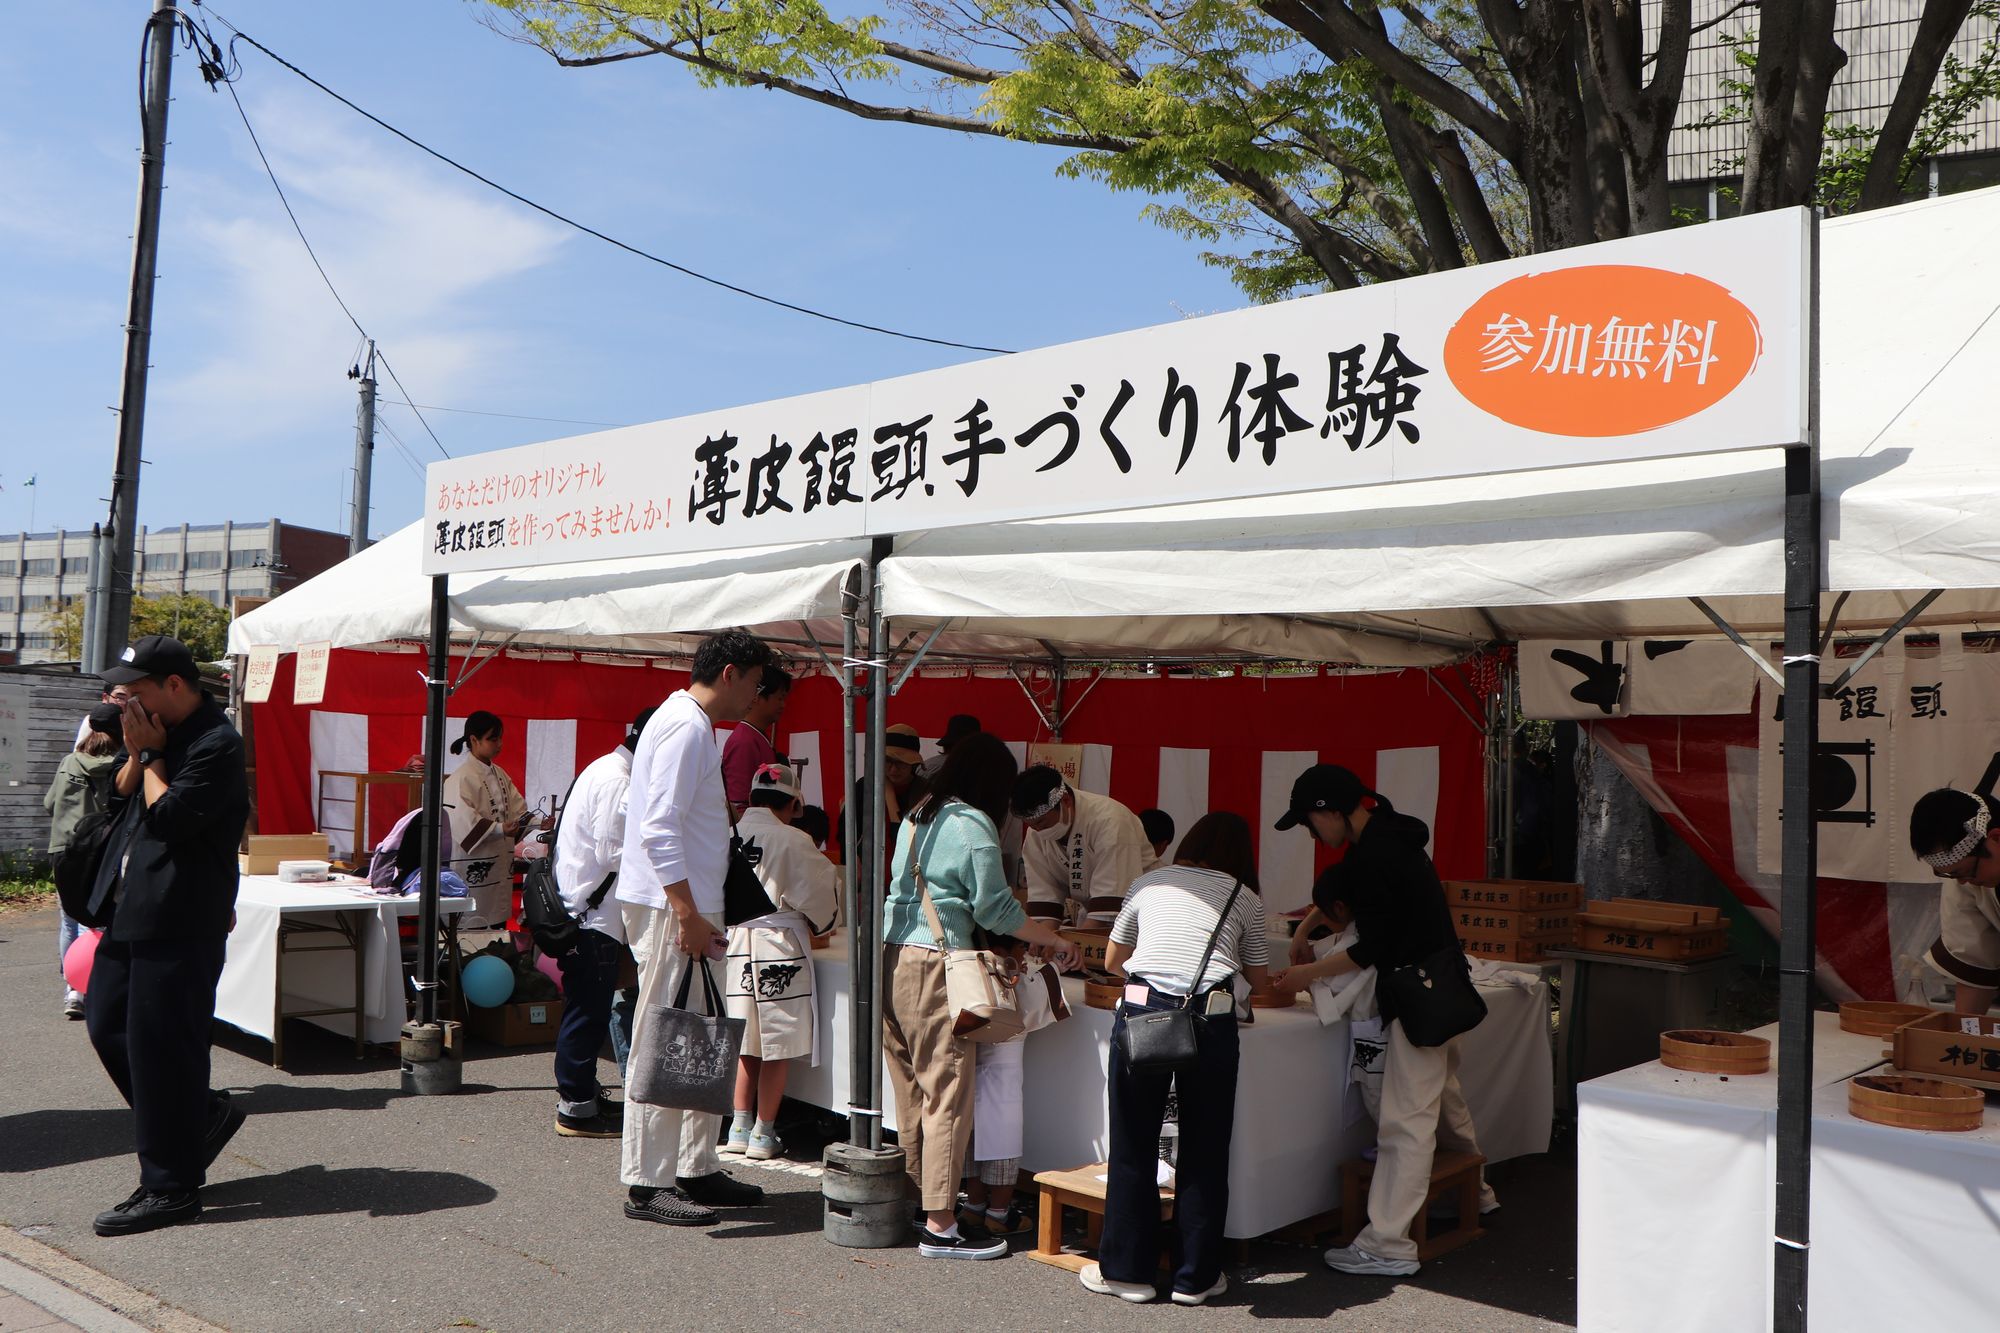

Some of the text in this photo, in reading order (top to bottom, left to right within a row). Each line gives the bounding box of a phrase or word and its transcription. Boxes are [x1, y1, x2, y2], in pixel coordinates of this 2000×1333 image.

[1478, 312, 1720, 385] 参加無料
[687, 332, 1429, 525] 薄皮饅頭手づくり体験
[437, 461, 607, 513] あなただけのオリジナル
